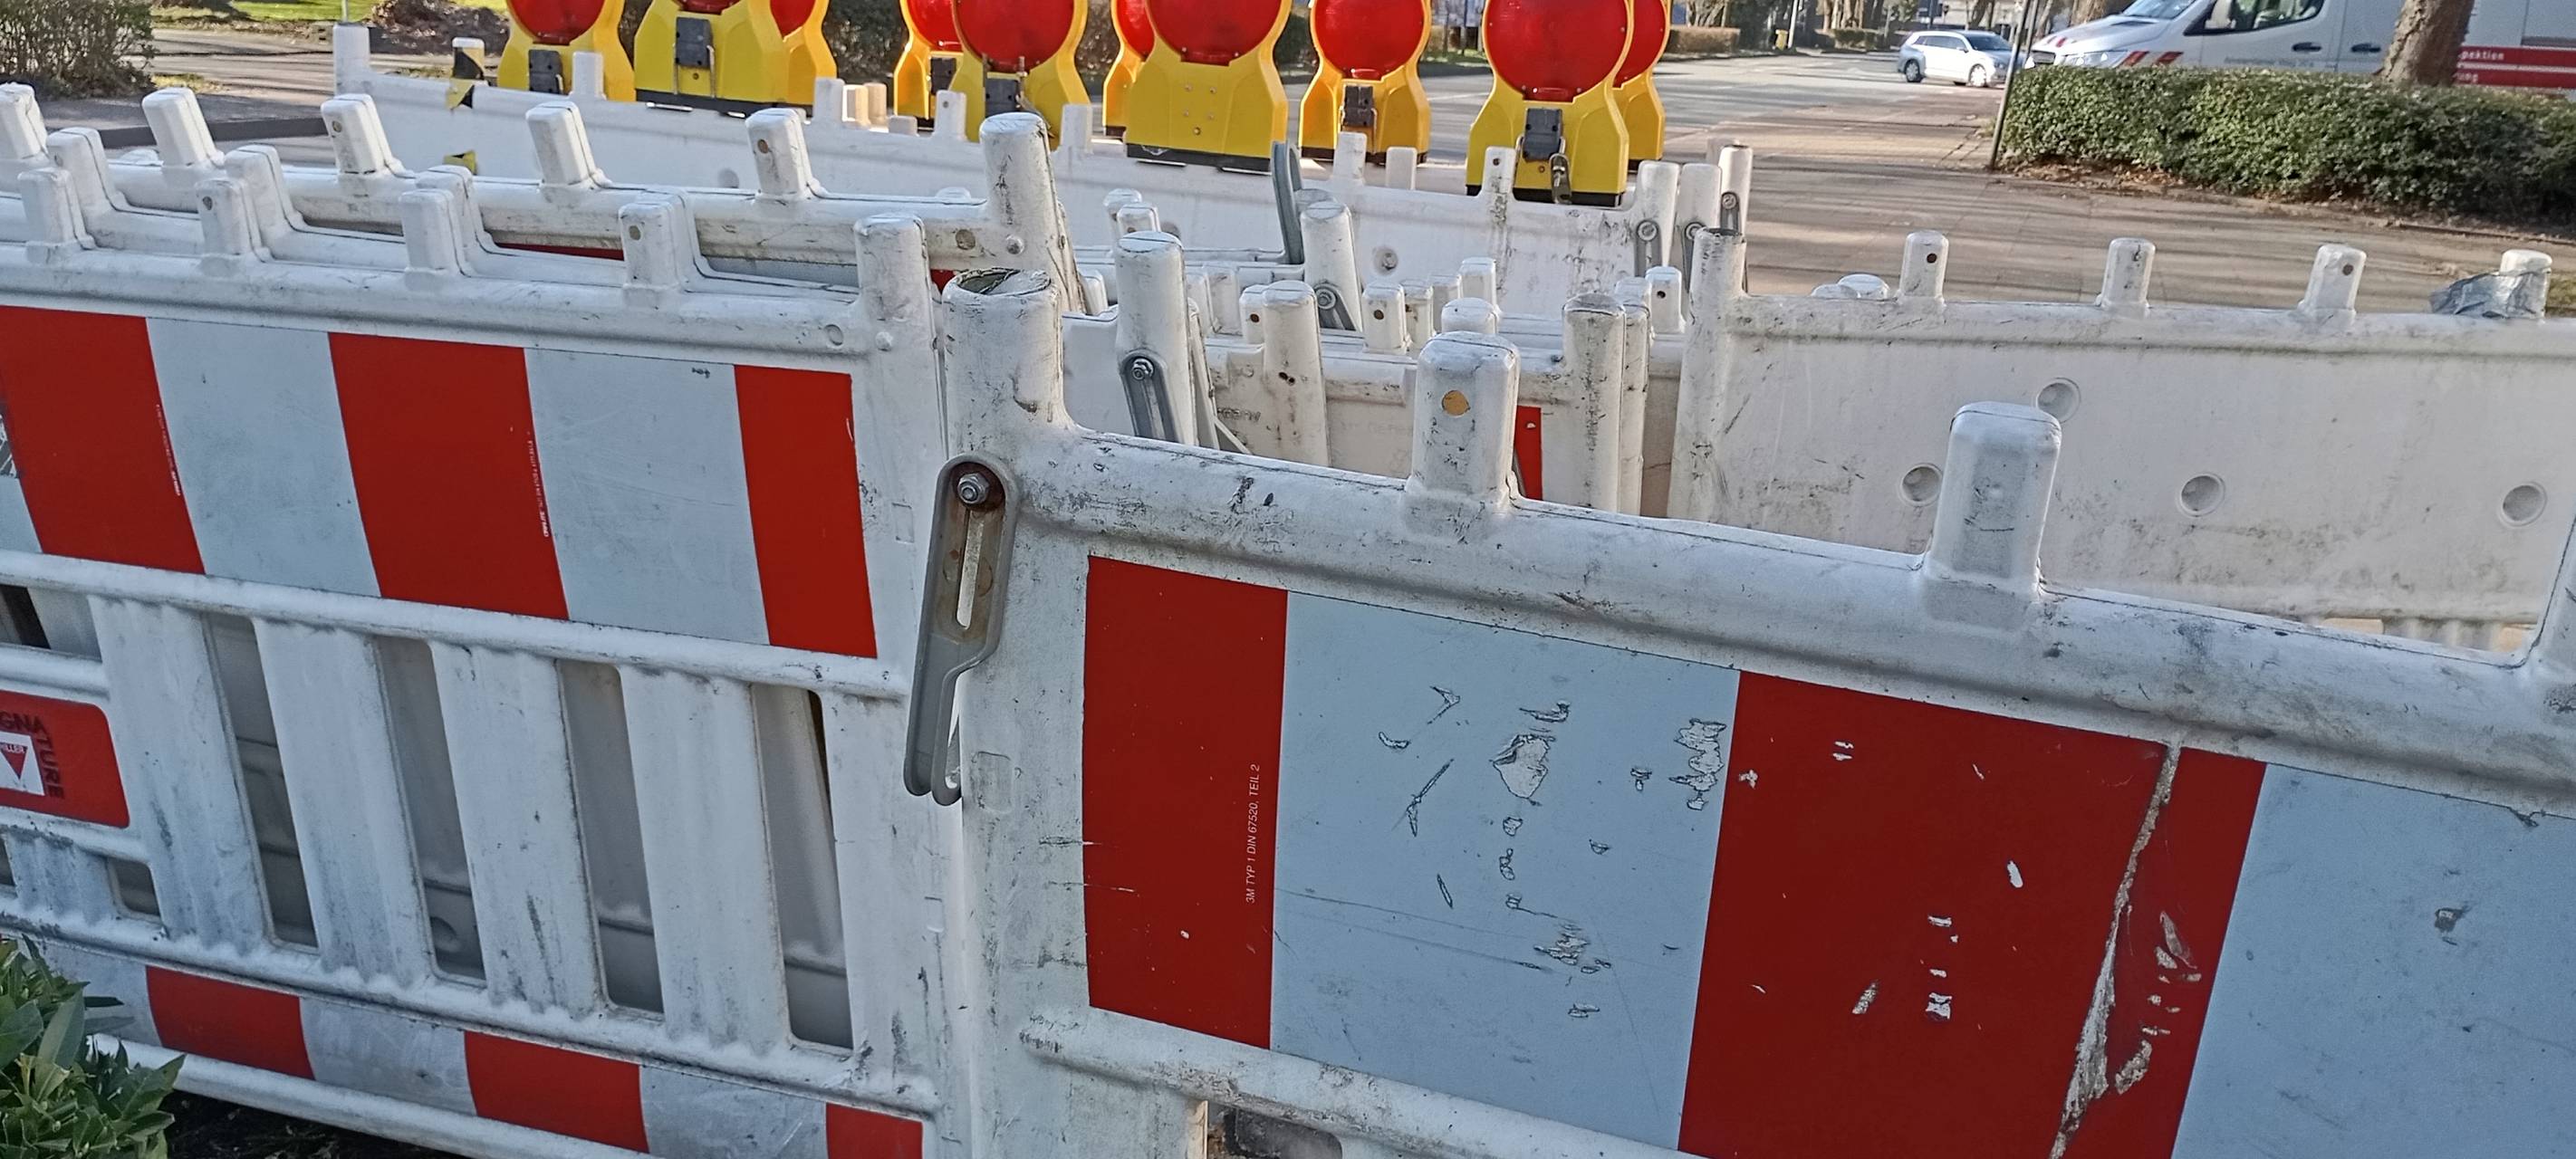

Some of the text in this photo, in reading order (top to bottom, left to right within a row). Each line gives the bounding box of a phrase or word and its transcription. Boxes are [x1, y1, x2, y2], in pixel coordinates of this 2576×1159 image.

[1250, 763, 1260, 771] 2
[1249, 775, 1260, 797] TEIL
[1246, 836, 1256, 855] DIN
[1246, 865, 1255, 886] TYP
[1246, 888, 1254, 904] 3M
